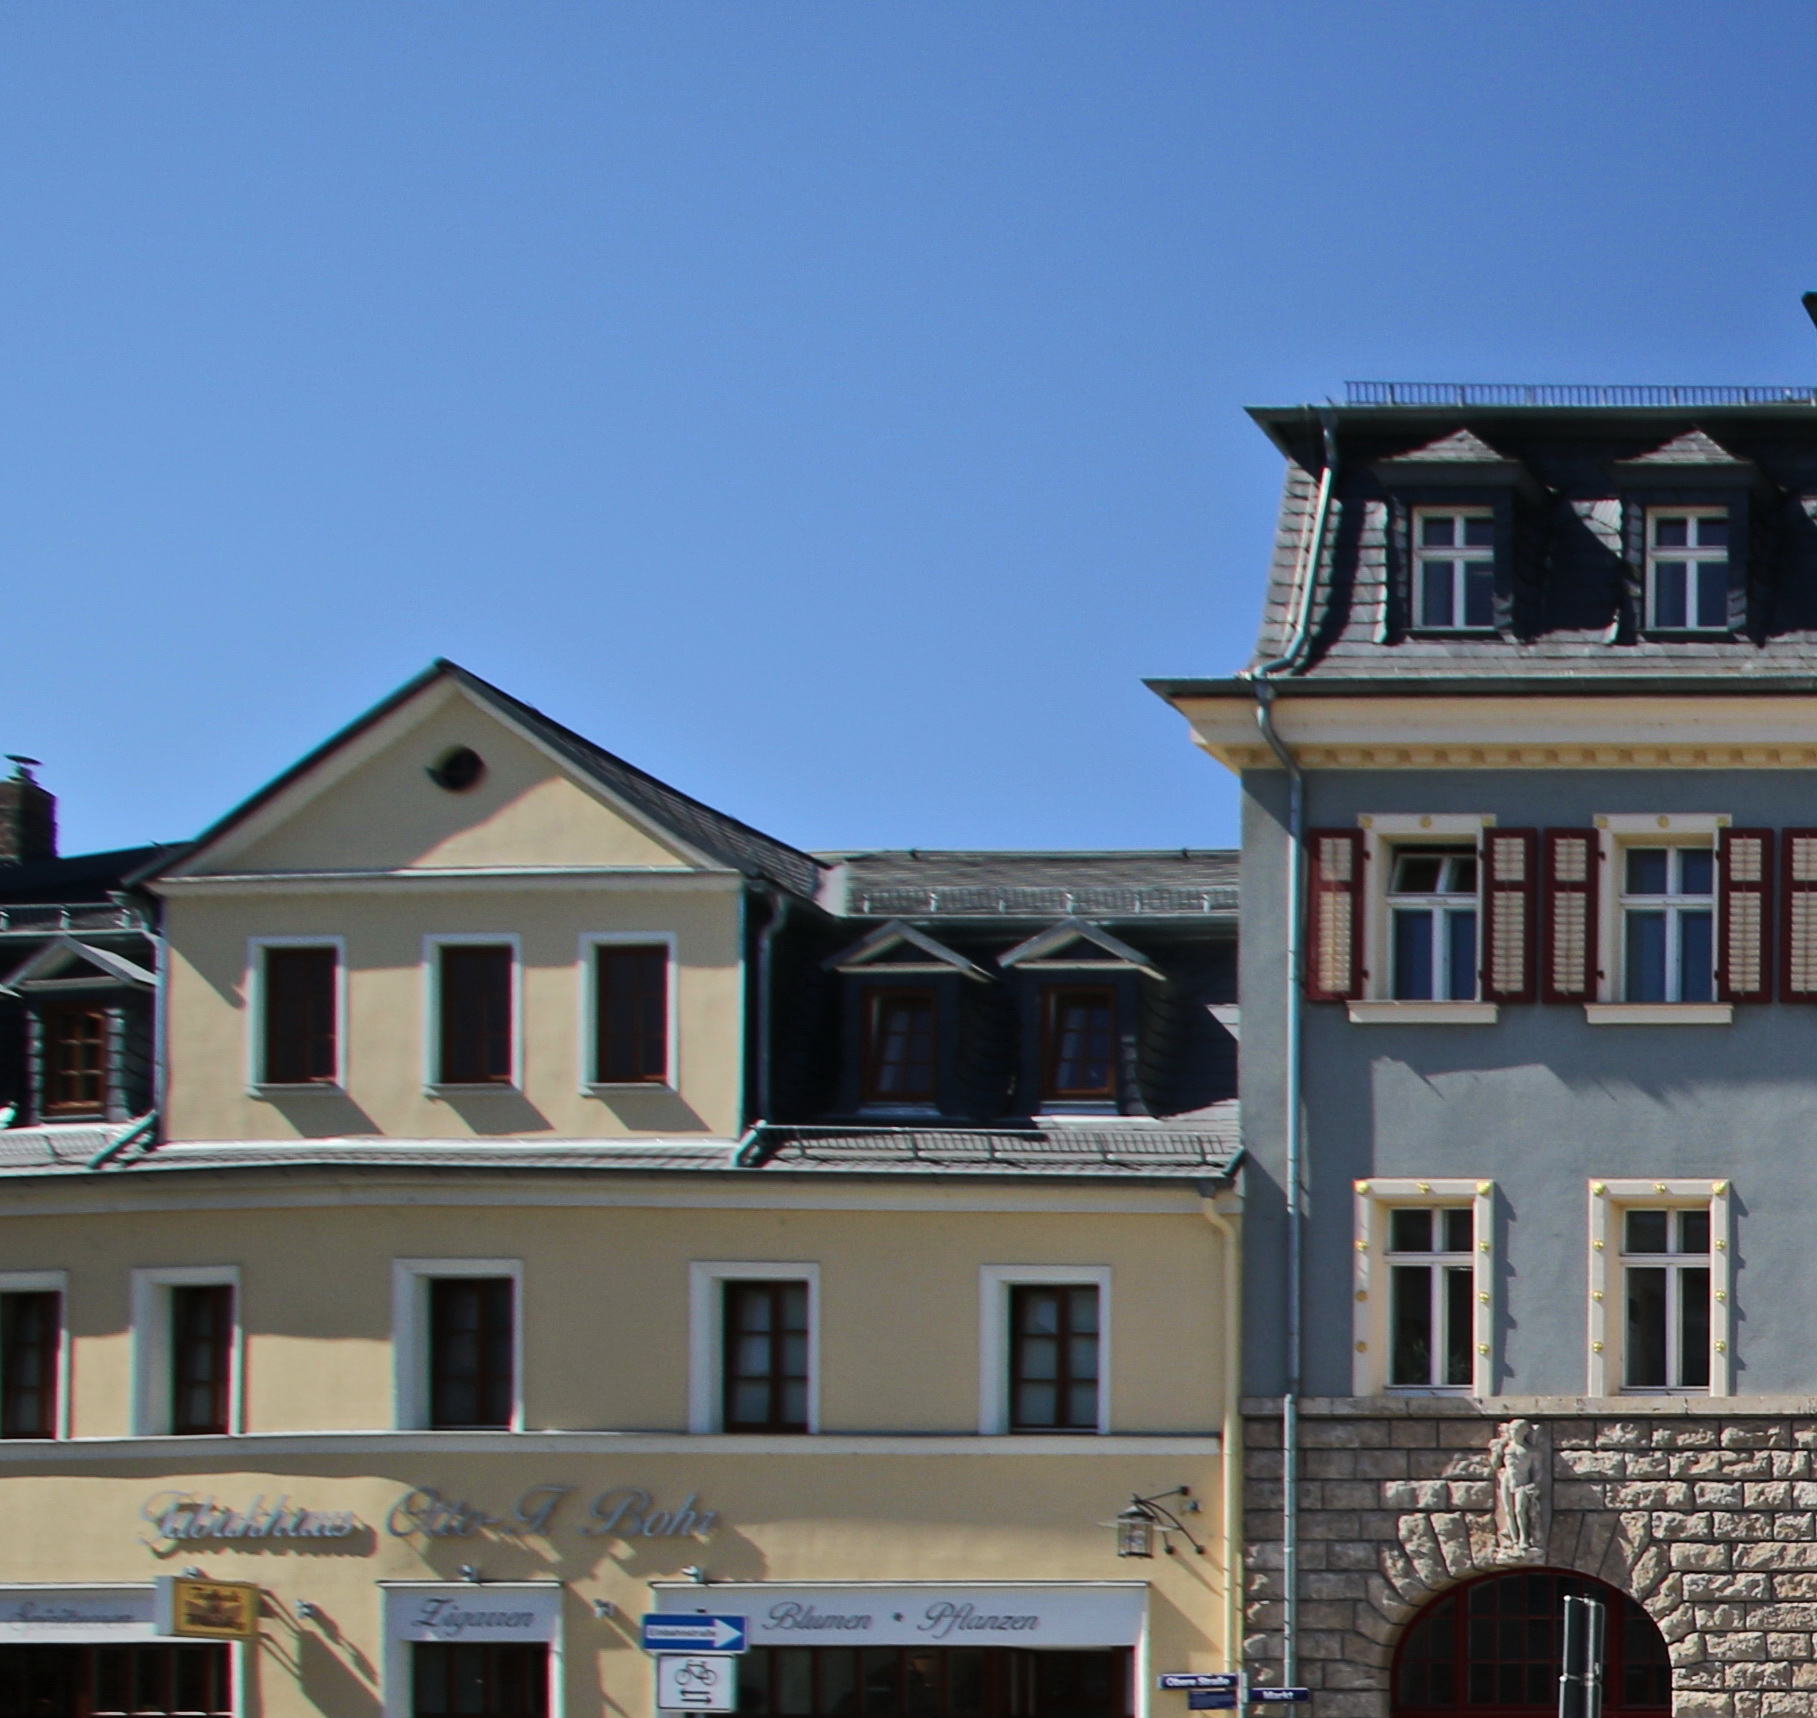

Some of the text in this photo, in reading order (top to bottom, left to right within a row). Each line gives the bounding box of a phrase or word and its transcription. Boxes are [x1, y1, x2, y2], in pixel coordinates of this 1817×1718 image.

[580, 1485, 717, 1537] Bohr
[761, 1601, 1040, 1640] Blumen Pflanzen
[1166, 1677, 1196, 1687] Obere
[1262, 1690, 1294, 1700] Markt
